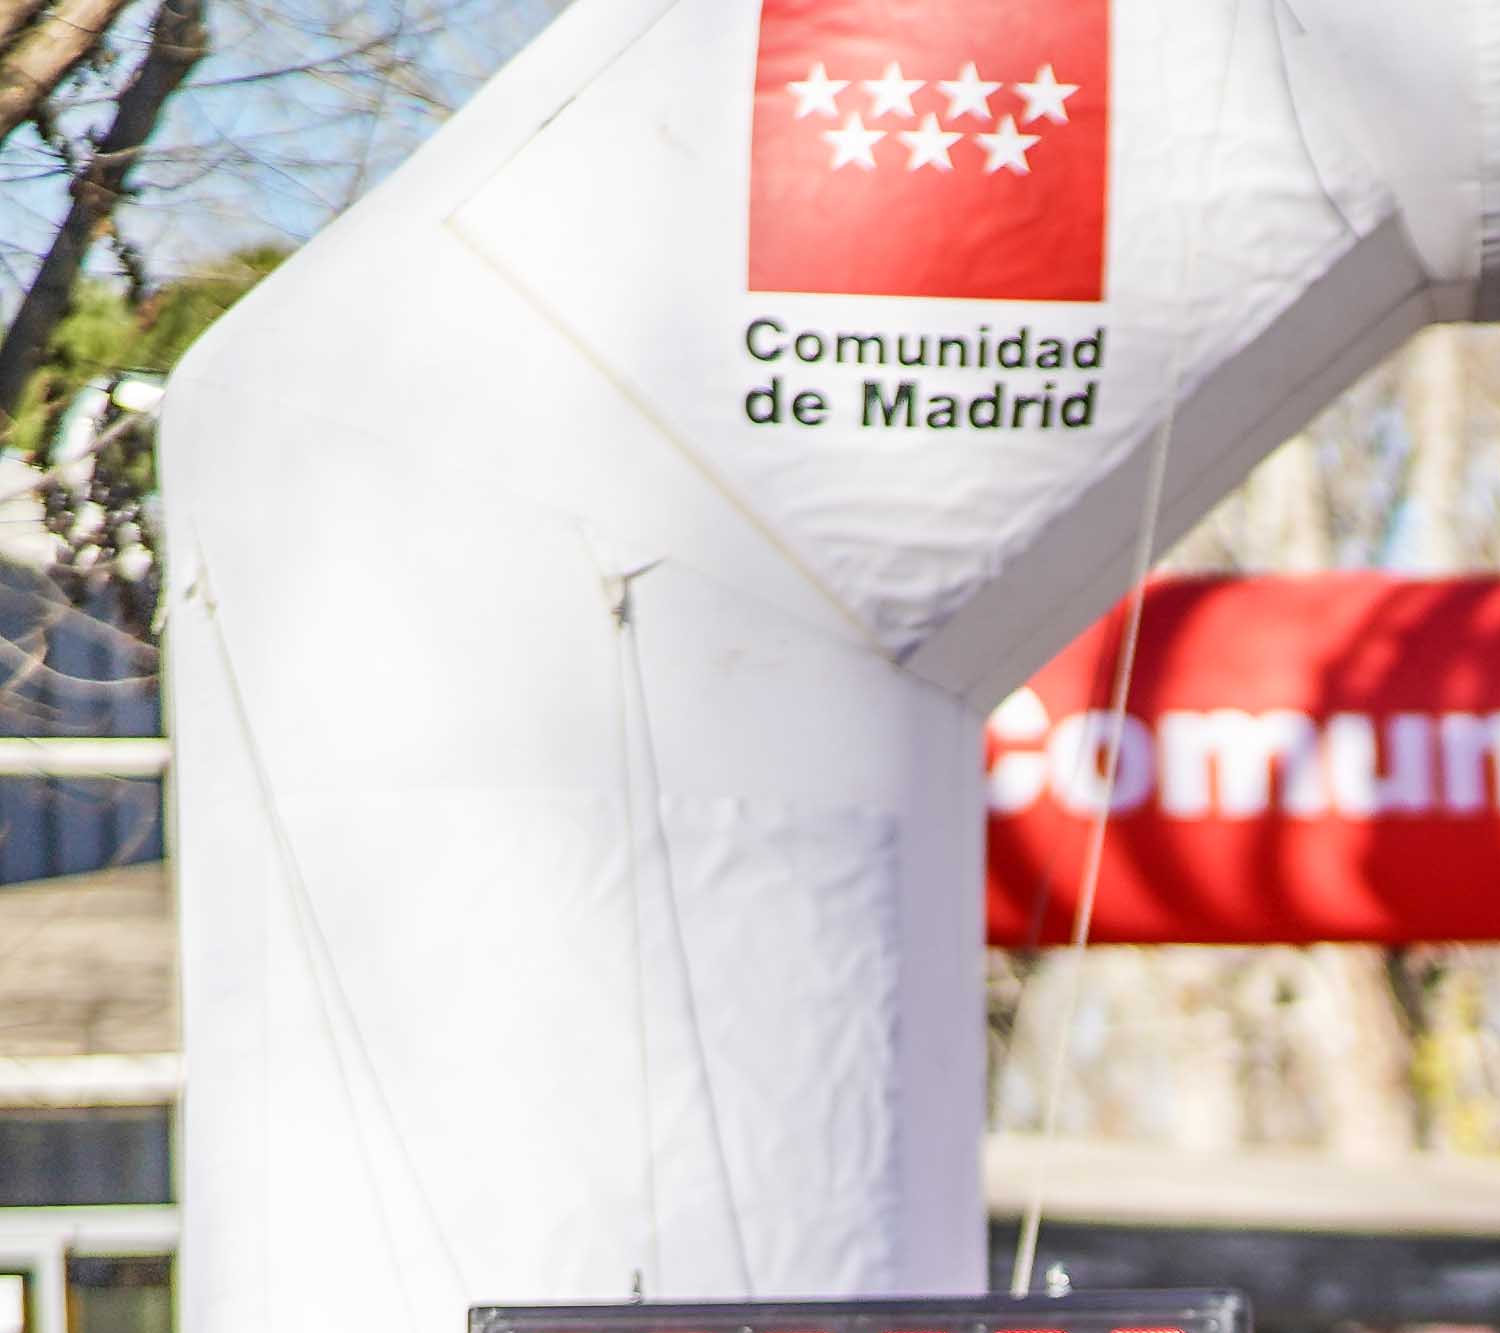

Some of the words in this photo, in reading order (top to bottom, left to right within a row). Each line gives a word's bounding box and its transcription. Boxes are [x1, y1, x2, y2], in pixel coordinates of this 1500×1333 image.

[745, 315, 1105, 369] Comunidad
[745, 376, 829, 425] de
[861, 380, 1098, 429] Madrid
